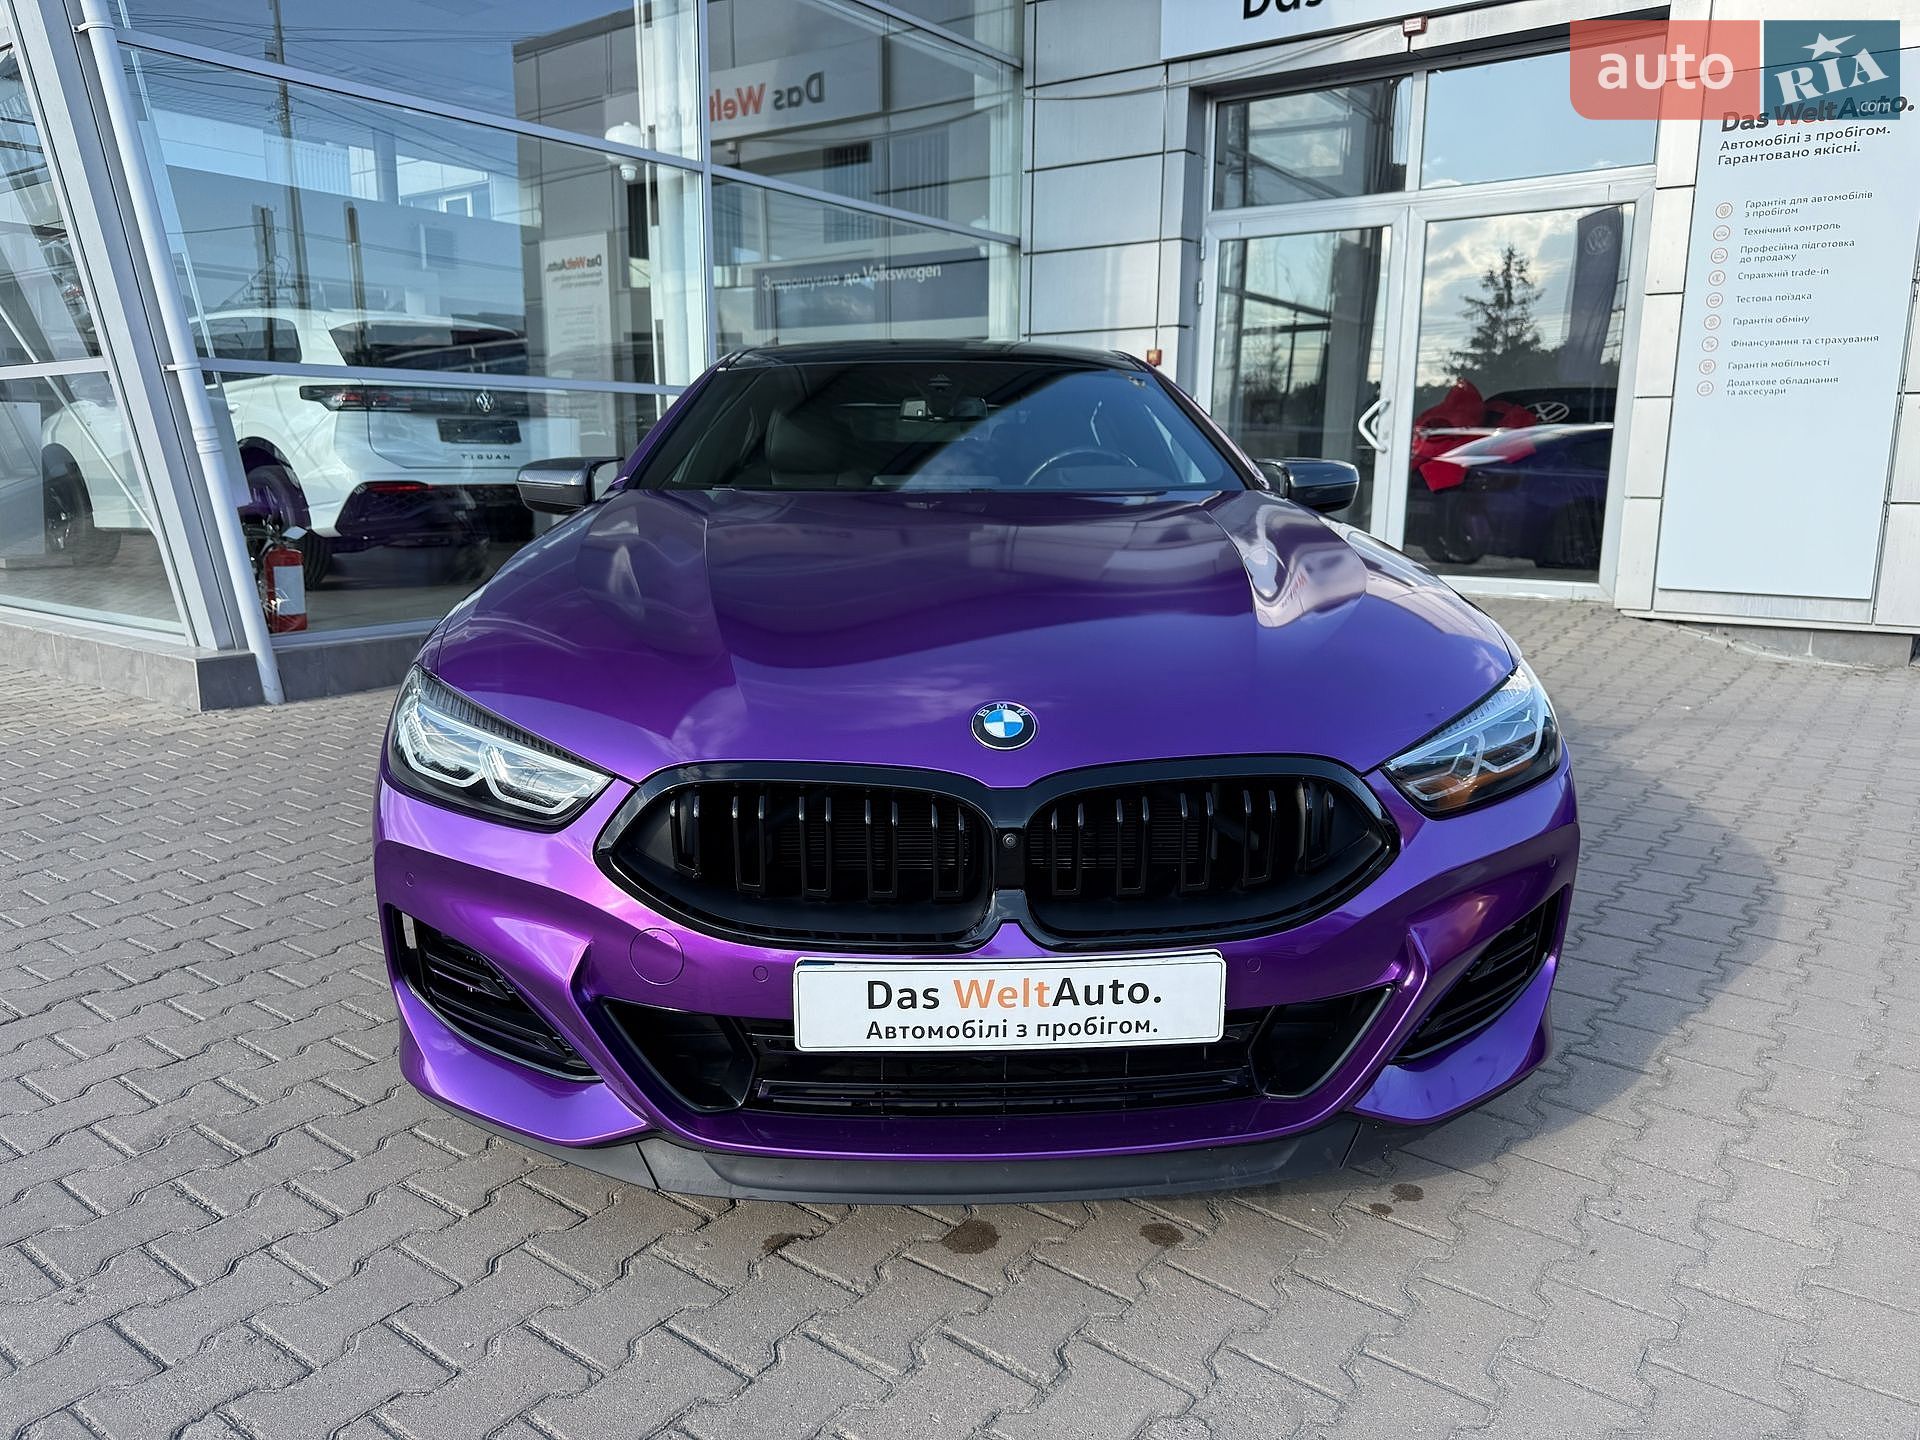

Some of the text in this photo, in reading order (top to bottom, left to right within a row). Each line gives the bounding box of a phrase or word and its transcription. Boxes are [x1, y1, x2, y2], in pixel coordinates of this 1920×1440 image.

[1721, 111, 1769, 133] Das
[1720, 125, 1891, 151] Автомобілі з пробігом.
[1718, 141, 1861, 167] Гарантовано якісні.
[1745, 191, 1873, 209] Гарантія для автомобілів
[1752, 207, 1799, 218] пробігом
[1743, 222, 1841, 236] Технічний контроль
[1740, 239, 1855, 255] Професійна підготовка
[1739, 253, 1797, 264] до продажу
[862, 263, 942, 283] Volkswagen
[1791, 267, 1829, 277] trade-in
[1736, 292, 1812, 304] Тестова поїздка
[1732, 314, 1810, 327] Гарантія обміну
[1815, 334, 1880, 346] страхування
[1727, 358, 1830, 371] Гарантія мобільності
[1726, 376, 1839, 388] Додаткове обладнання
[977, 702, 1029, 717] BMW
[865, 976, 1163, 1012] Das WeltAuto.
[865, 1015, 1158, 1043] Автомобілі з пробігом.
